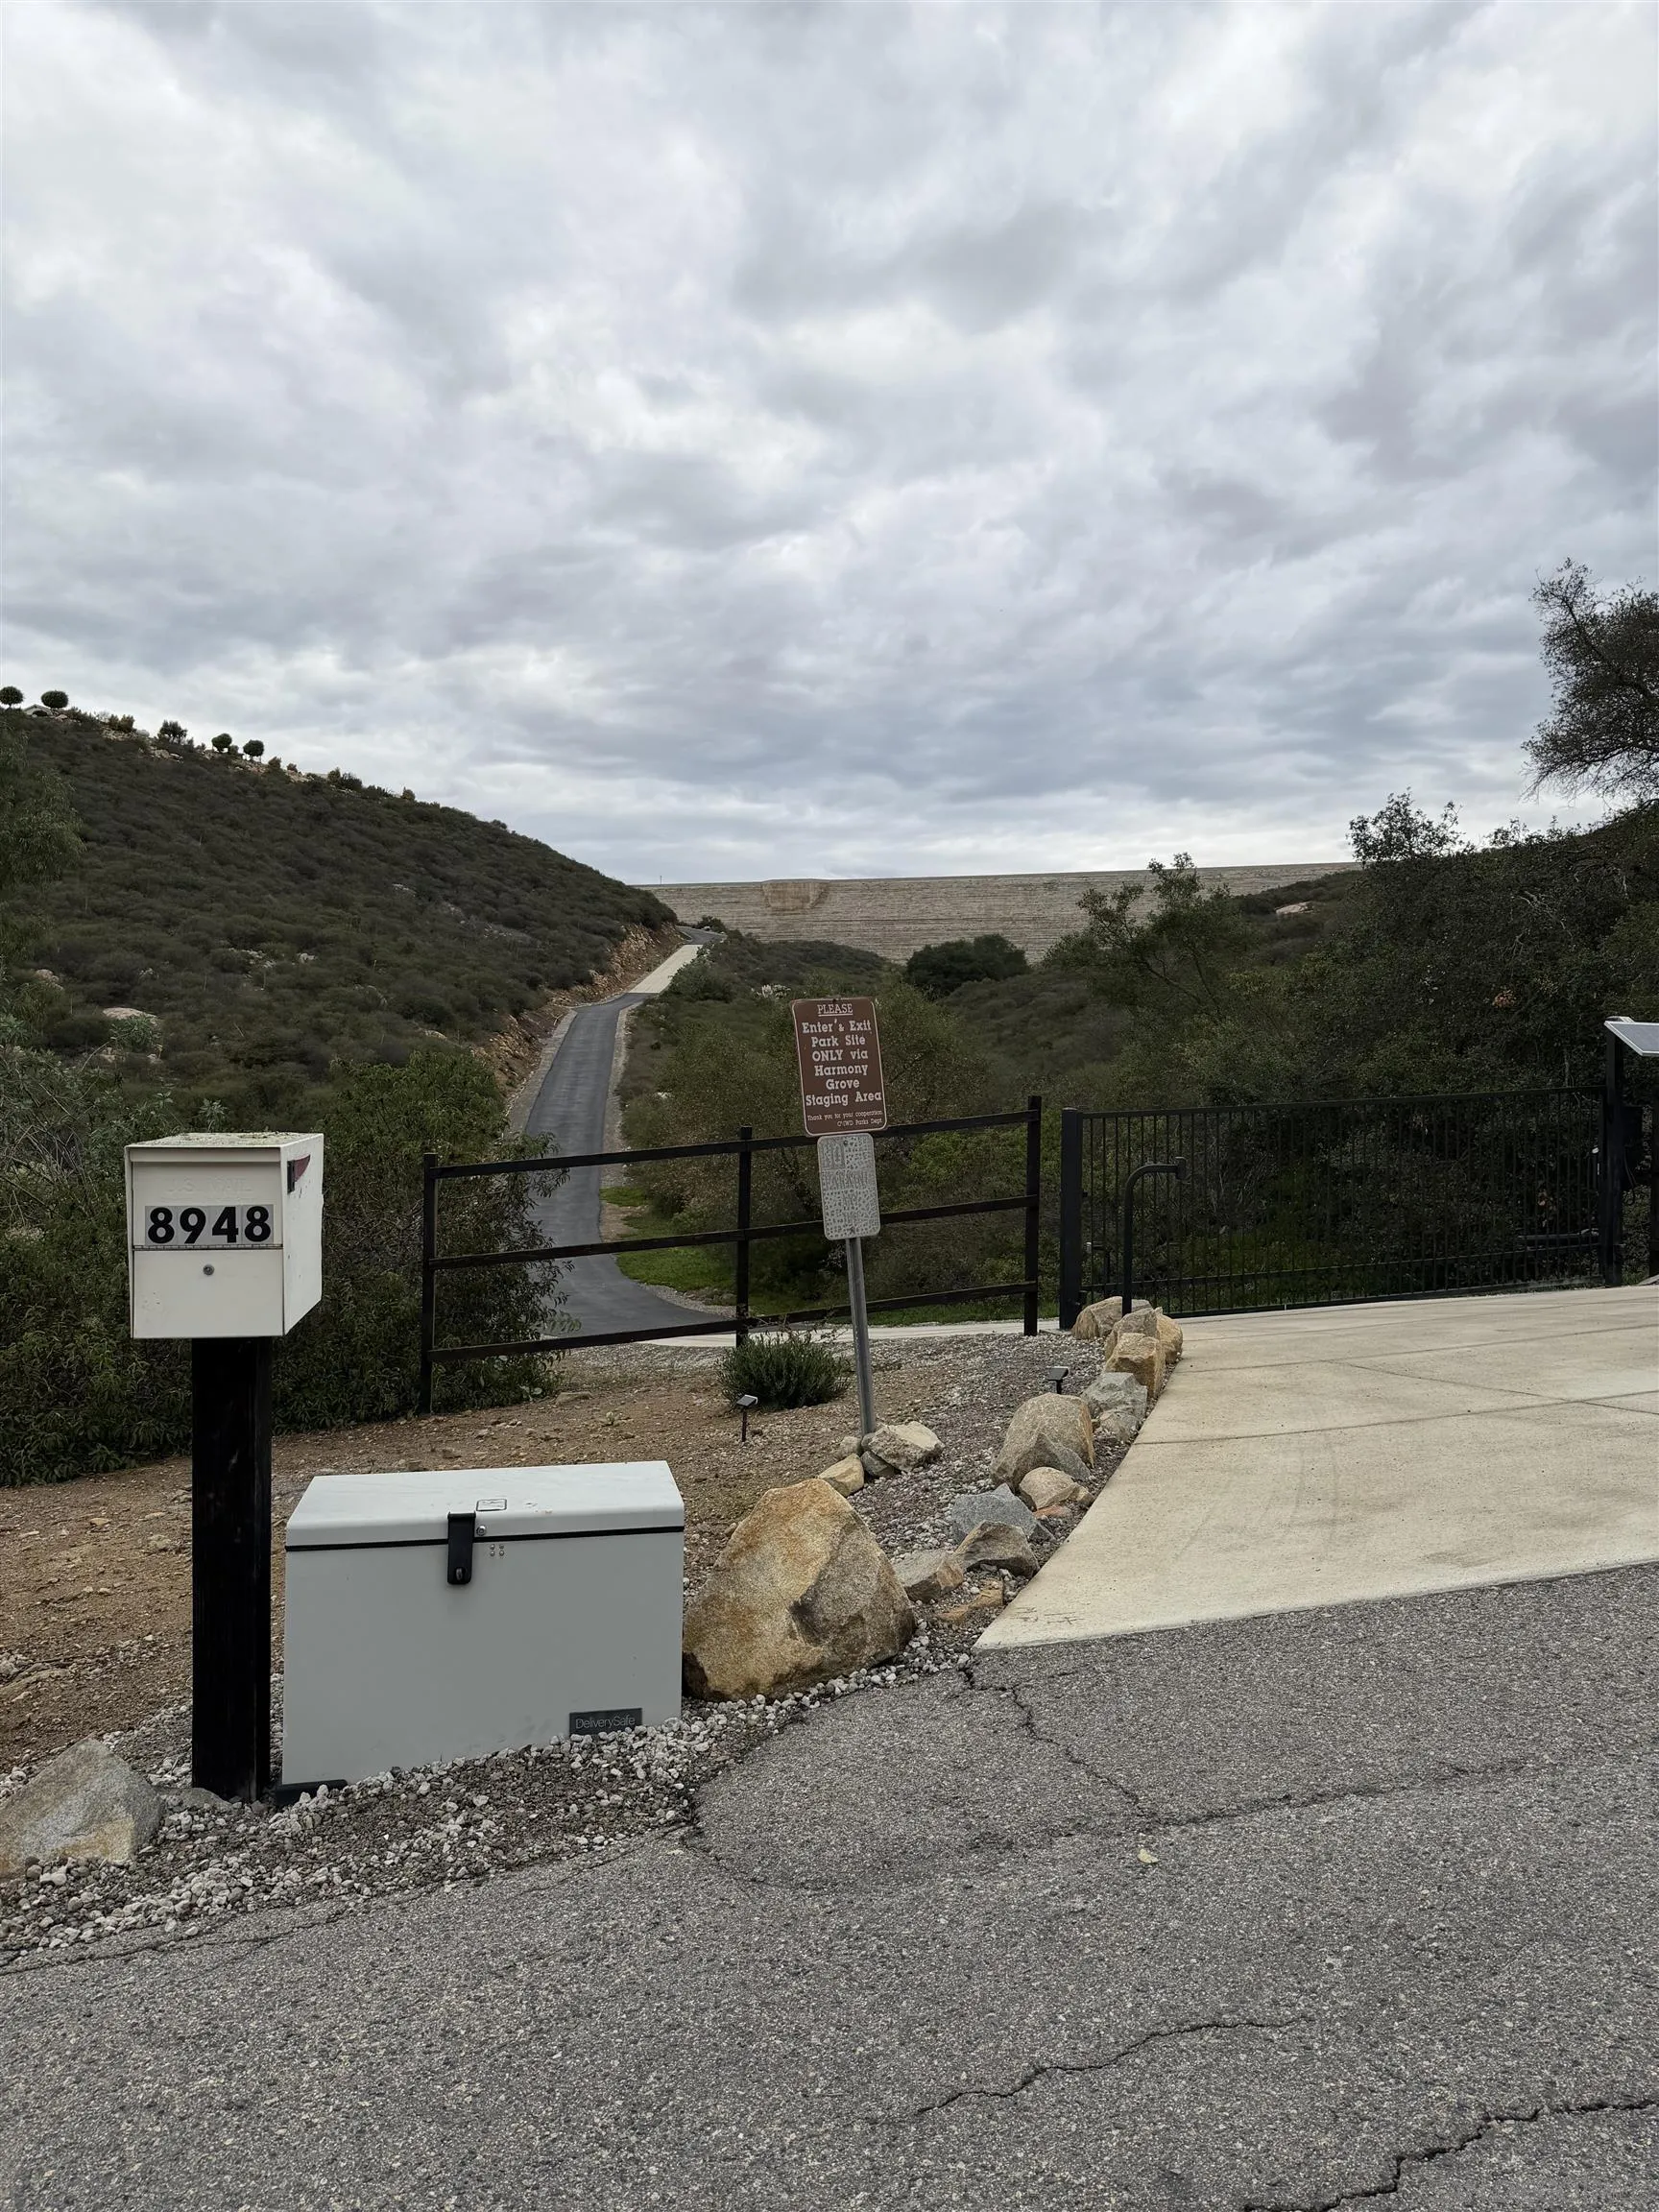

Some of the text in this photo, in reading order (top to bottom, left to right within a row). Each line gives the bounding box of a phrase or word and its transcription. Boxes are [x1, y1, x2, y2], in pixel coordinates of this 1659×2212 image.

[817, 1003, 854, 1014] PLEASE
[838, 1023, 845, 1032] &
[849, 1020, 872, 1031] Exit
[811, 1034, 866, 1047] Park Site
[812, 1049, 869, 1062] ONLY via
[814, 1064, 869, 1076] Harmony
[826, 1078, 860, 1091] Grove
[805, 1091, 881, 1108] Staging Area
[147, 1206, 272, 1244] 8948
[575, 1716, 636, 1729] DeliverySafe
